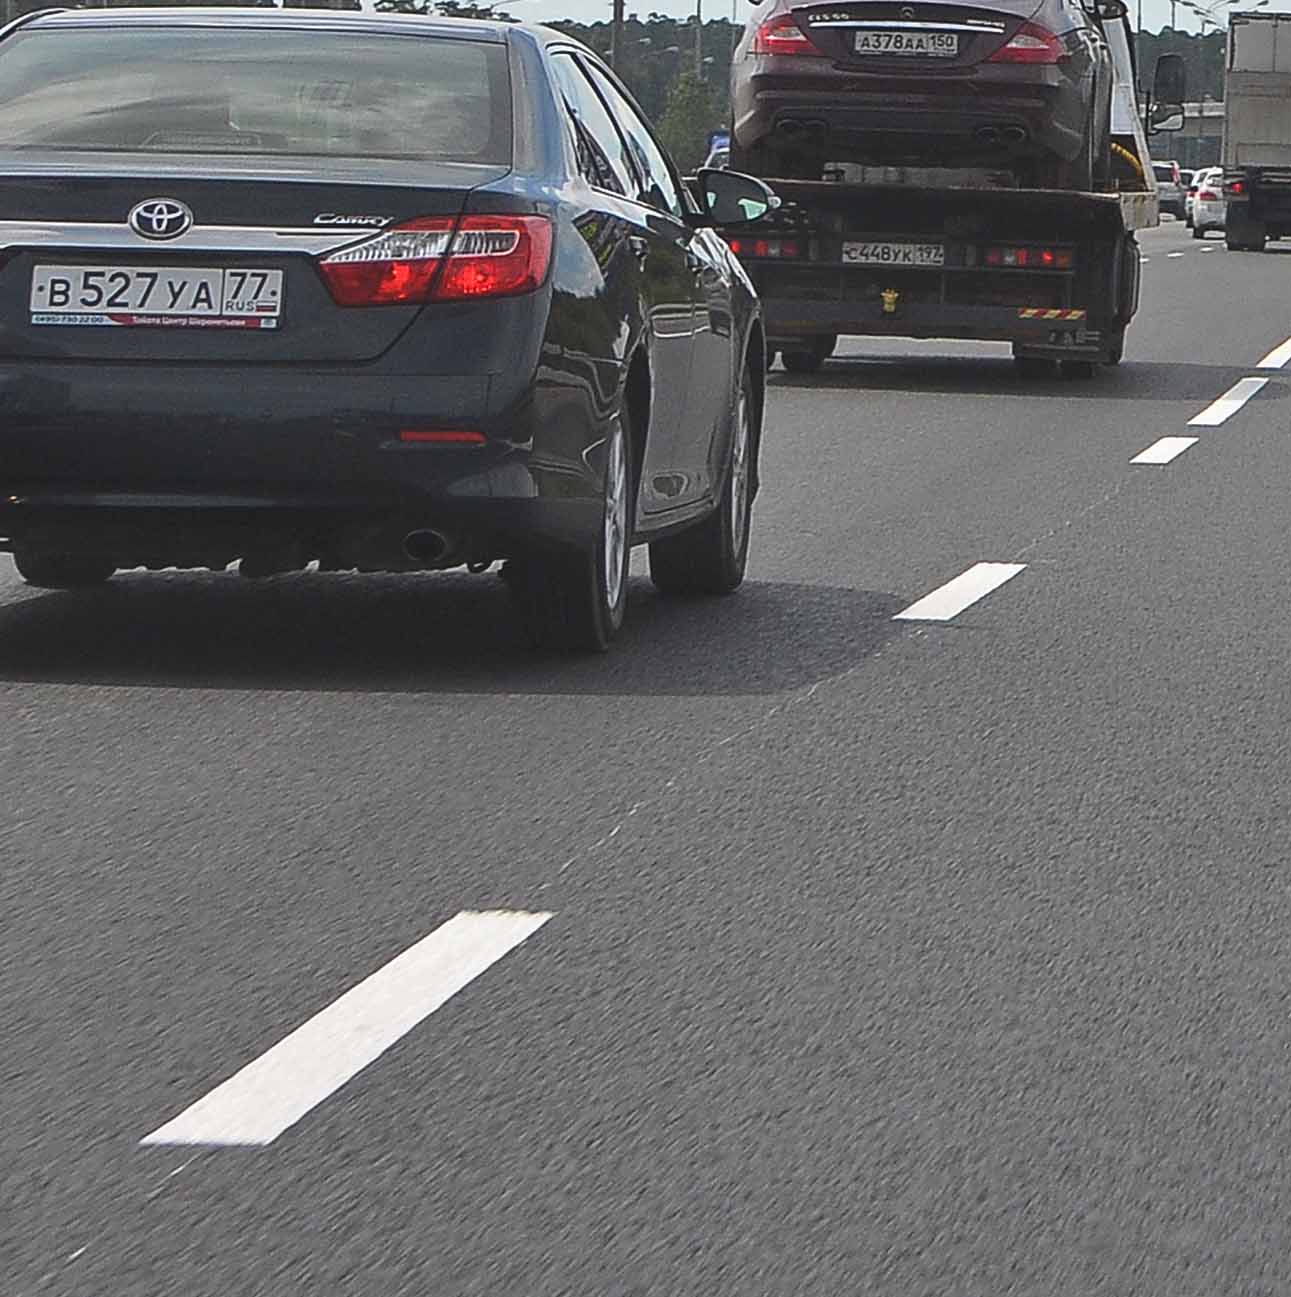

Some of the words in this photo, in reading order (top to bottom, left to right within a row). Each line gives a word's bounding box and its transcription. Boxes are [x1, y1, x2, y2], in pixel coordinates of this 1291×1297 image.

[930, 34, 954, 48] 150
[313, 212, 396, 227] Camry
[229, 272, 268, 301] 77
[226, 301, 255, 312] RUS
